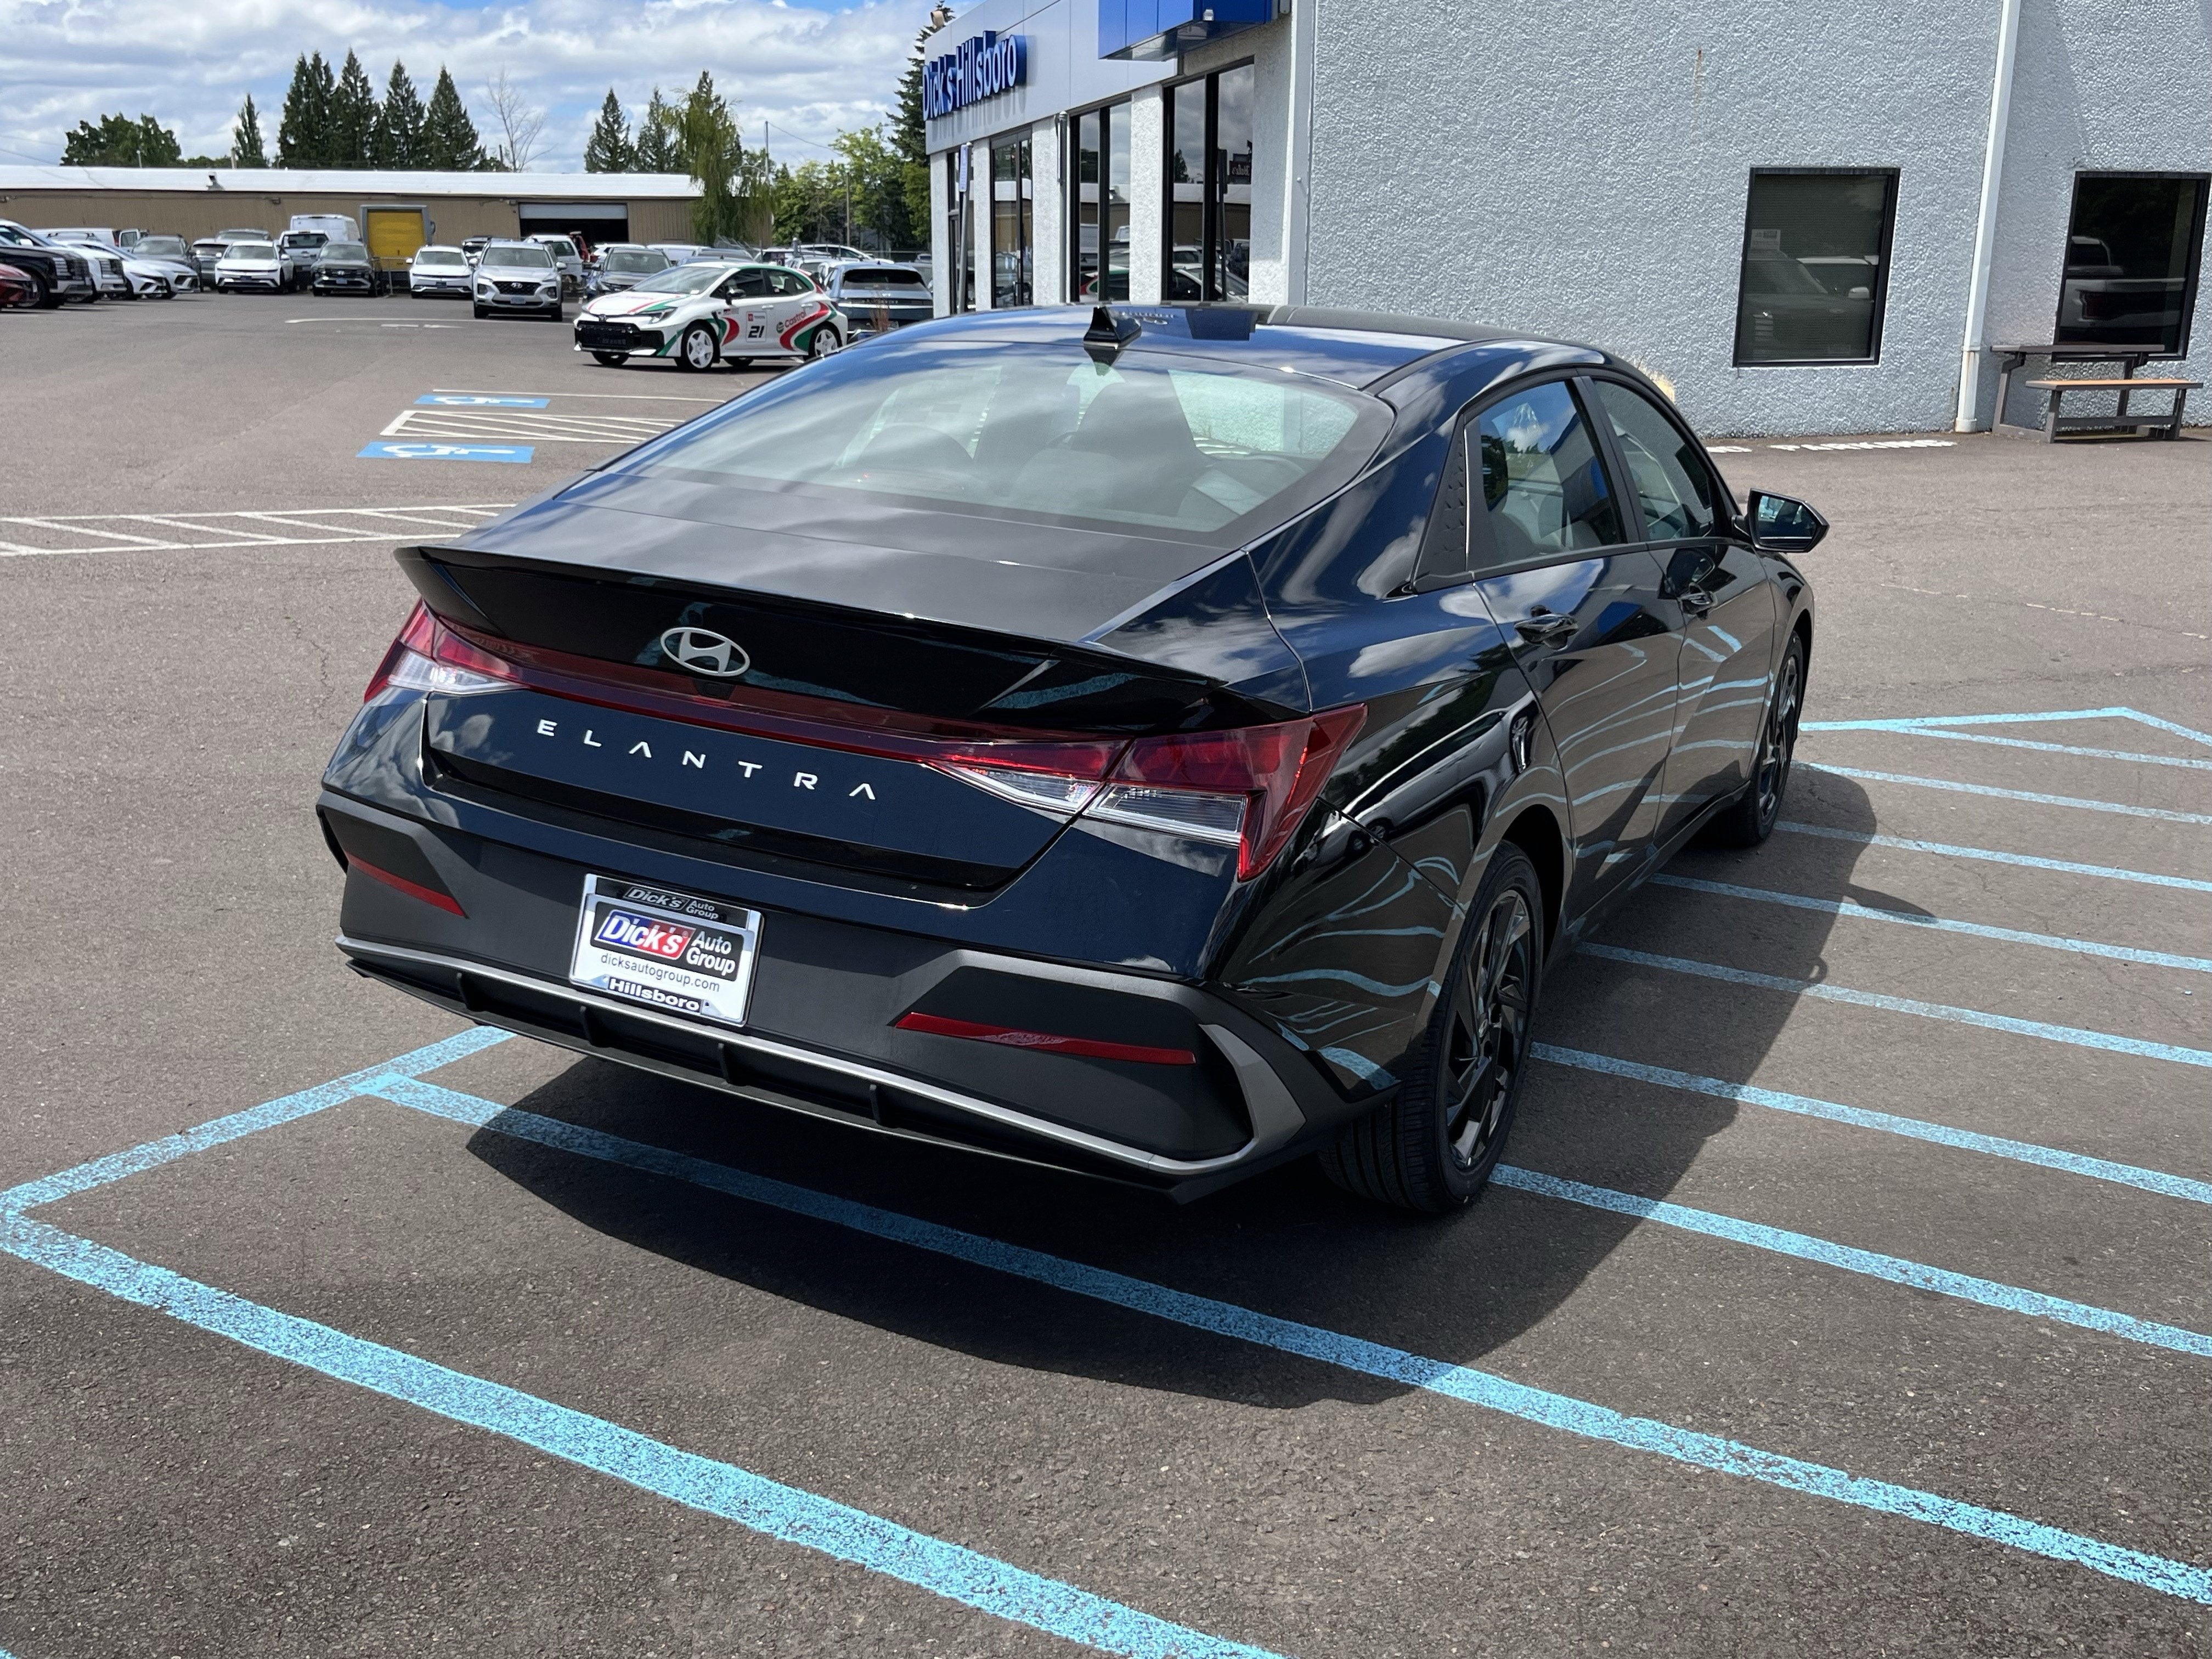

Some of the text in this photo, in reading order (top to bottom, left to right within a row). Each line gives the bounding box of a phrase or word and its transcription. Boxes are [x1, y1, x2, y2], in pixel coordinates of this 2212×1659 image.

[922, 30, 1019, 122] Dick's Hillsboro
[748, 325, 765, 338] 21
[784, 311, 806, 328] Castrol
[537, 719, 876, 800] ELANTRA
[627, 888, 683, 909] Dick's
[690, 900, 715, 912] Auto
[686, 906, 719, 920] Group
[603, 915, 684, 954] Dick's
[691, 931, 732, 955] Auto
[600, 952, 720, 992] dicksautogroup.com
[686, 947, 736, 976] Group
[609, 977, 700, 1012] Hillsboro
